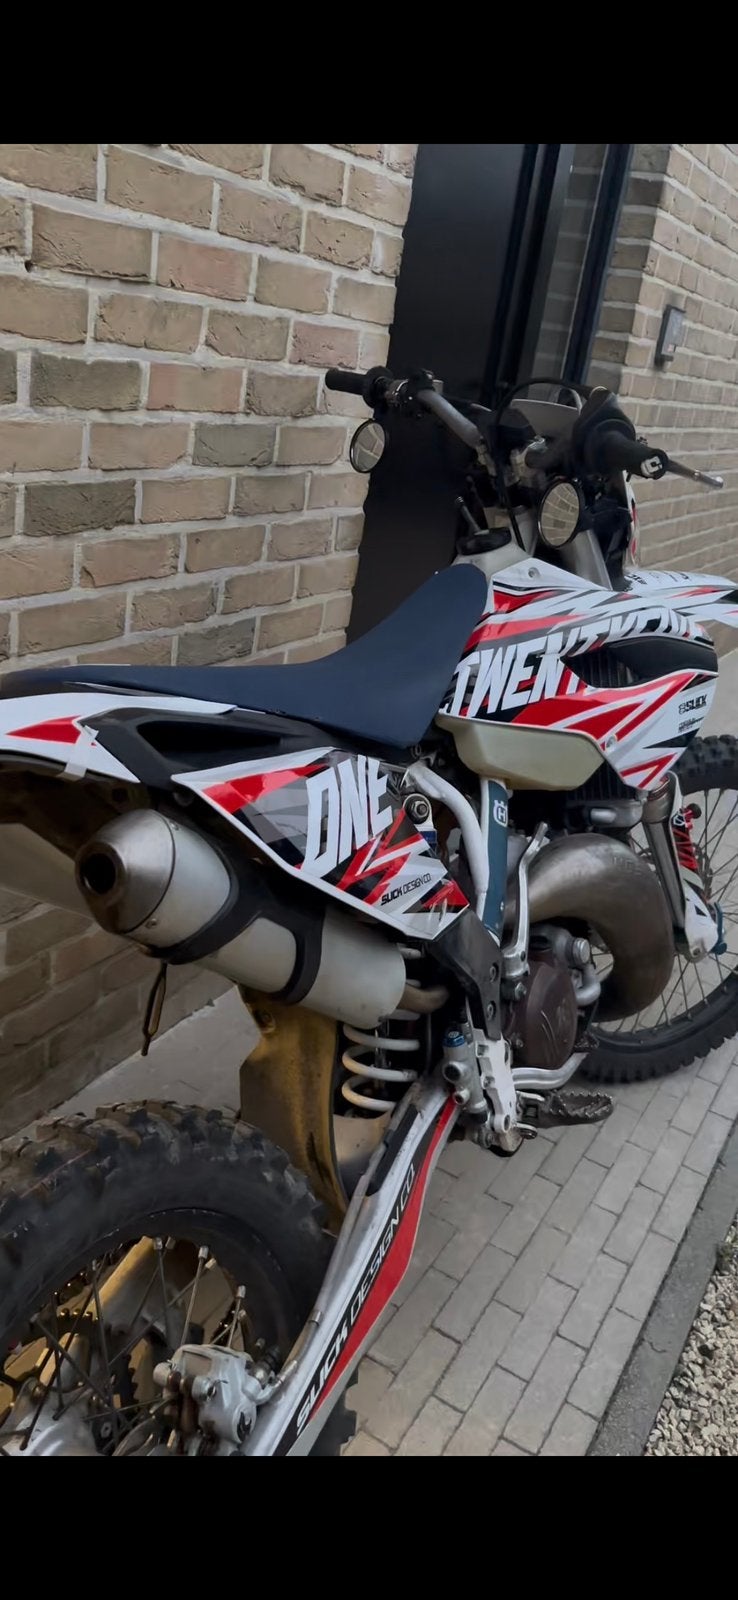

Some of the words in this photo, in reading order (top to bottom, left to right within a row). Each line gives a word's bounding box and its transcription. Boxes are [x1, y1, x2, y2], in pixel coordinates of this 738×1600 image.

[301, 754, 394, 879] ONE
[381, 886, 403, 906] SLICK
[402, 877, 424, 895] DESIGN
[296, 1318, 349, 1437] SLICK
[350, 1204, 400, 1327] DESIGN
